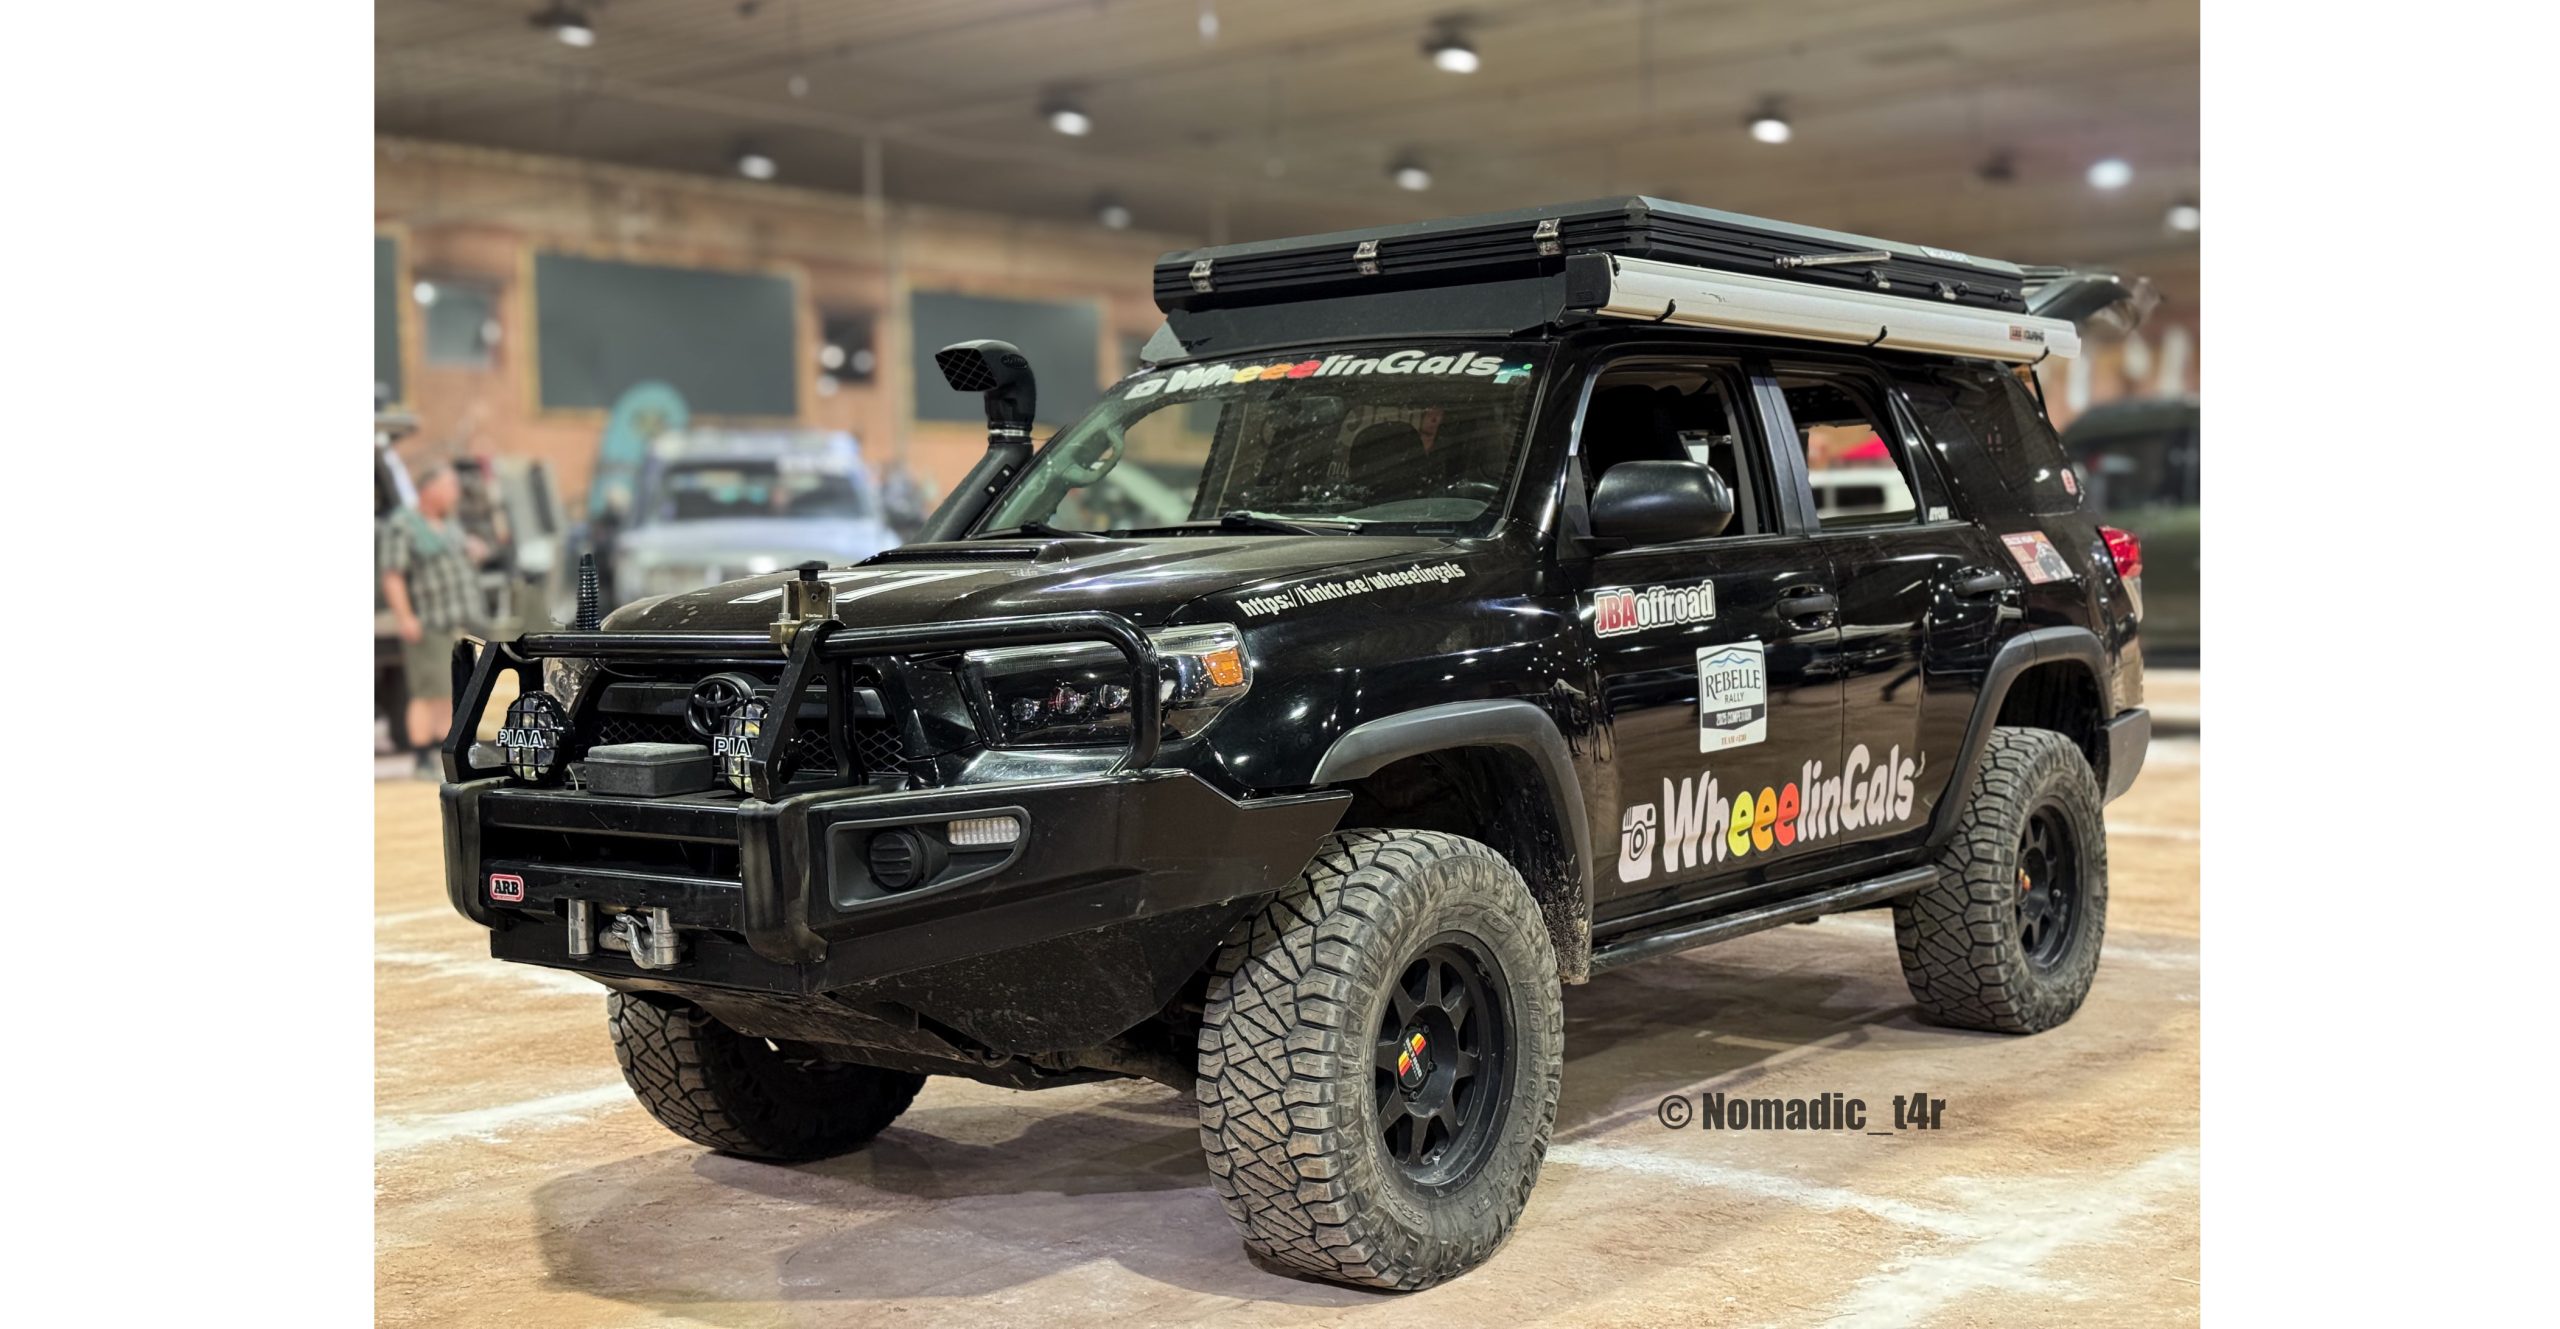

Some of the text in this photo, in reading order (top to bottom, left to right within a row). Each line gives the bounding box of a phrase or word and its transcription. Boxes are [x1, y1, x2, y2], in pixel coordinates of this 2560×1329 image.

[1236, 562, 1466, 618] https://linktr.ee/wheeelingals
[1705, 668, 1761, 700] REBELLE
[1724, 692, 1745, 704] RALLY
[496, 729, 544, 749] PIAA
[713, 736, 753, 758] PIA
[494, 880, 519, 896] ARB
